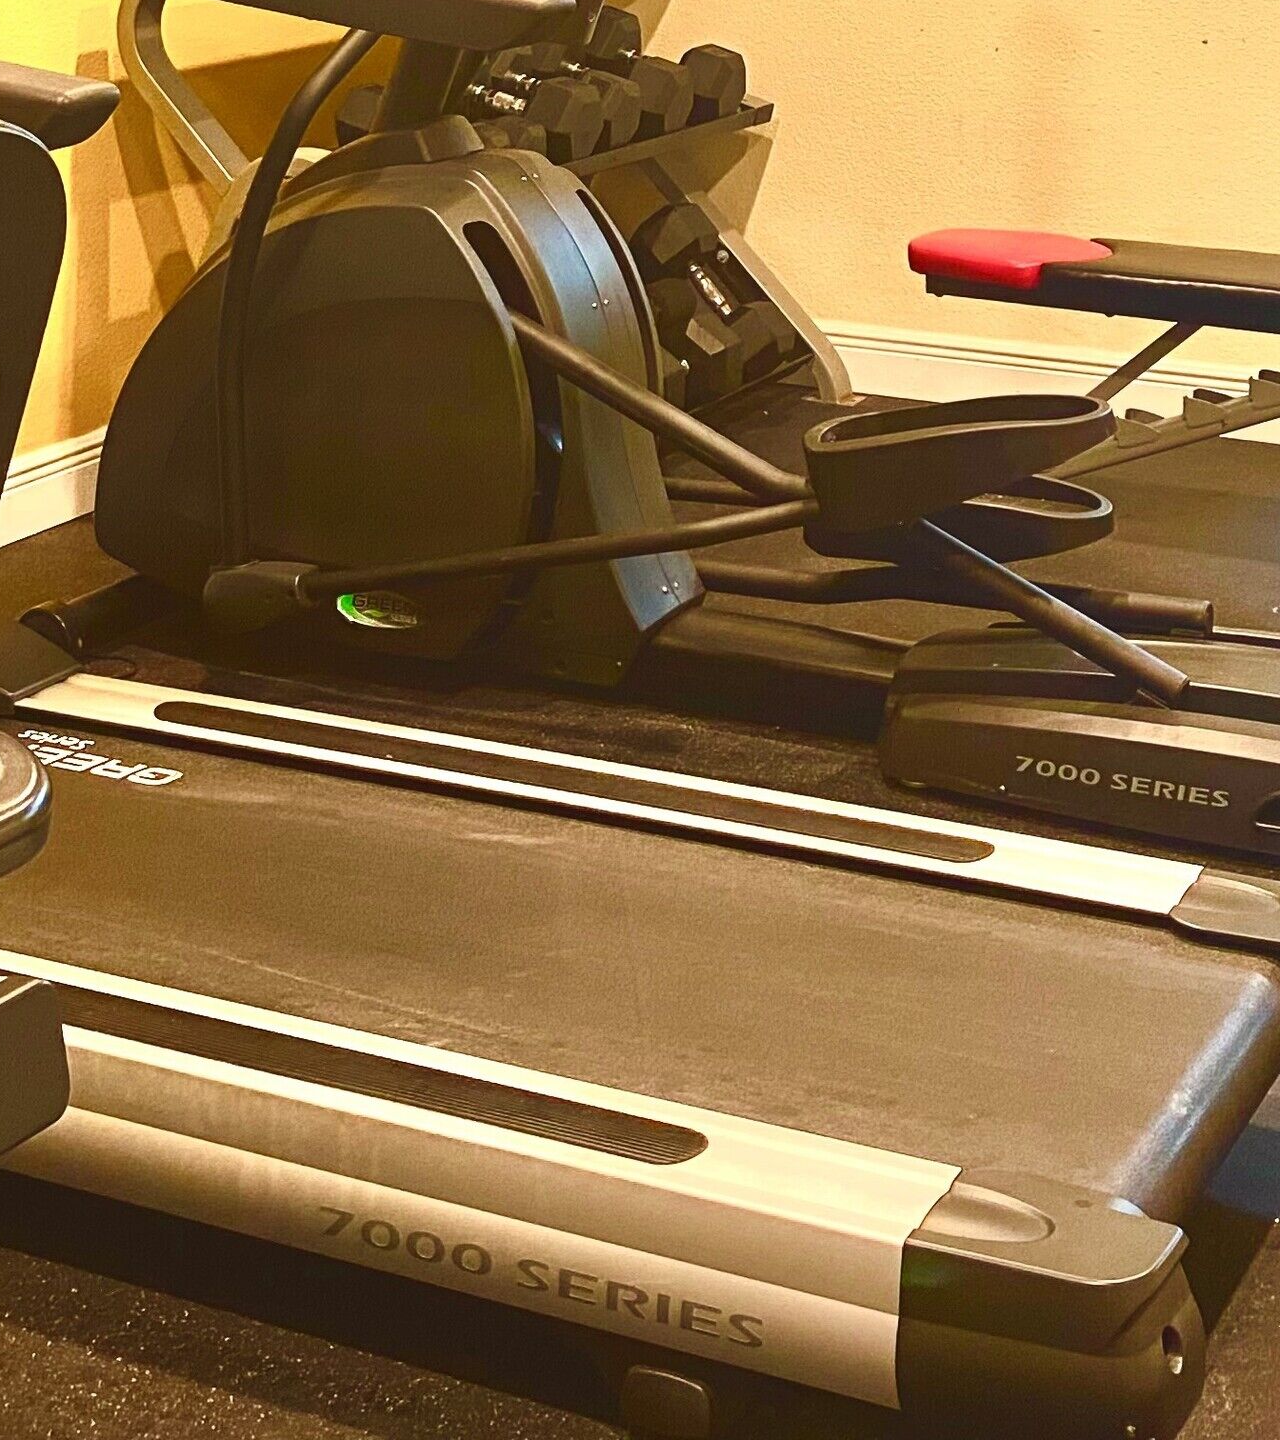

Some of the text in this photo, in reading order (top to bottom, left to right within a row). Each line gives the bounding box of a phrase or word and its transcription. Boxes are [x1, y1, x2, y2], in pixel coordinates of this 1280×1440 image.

[27, 743, 185, 787] GREE
[1014, 755, 1231, 809] 7000 SERIES
[320, 1205, 765, 1349] 7000 SERIES
